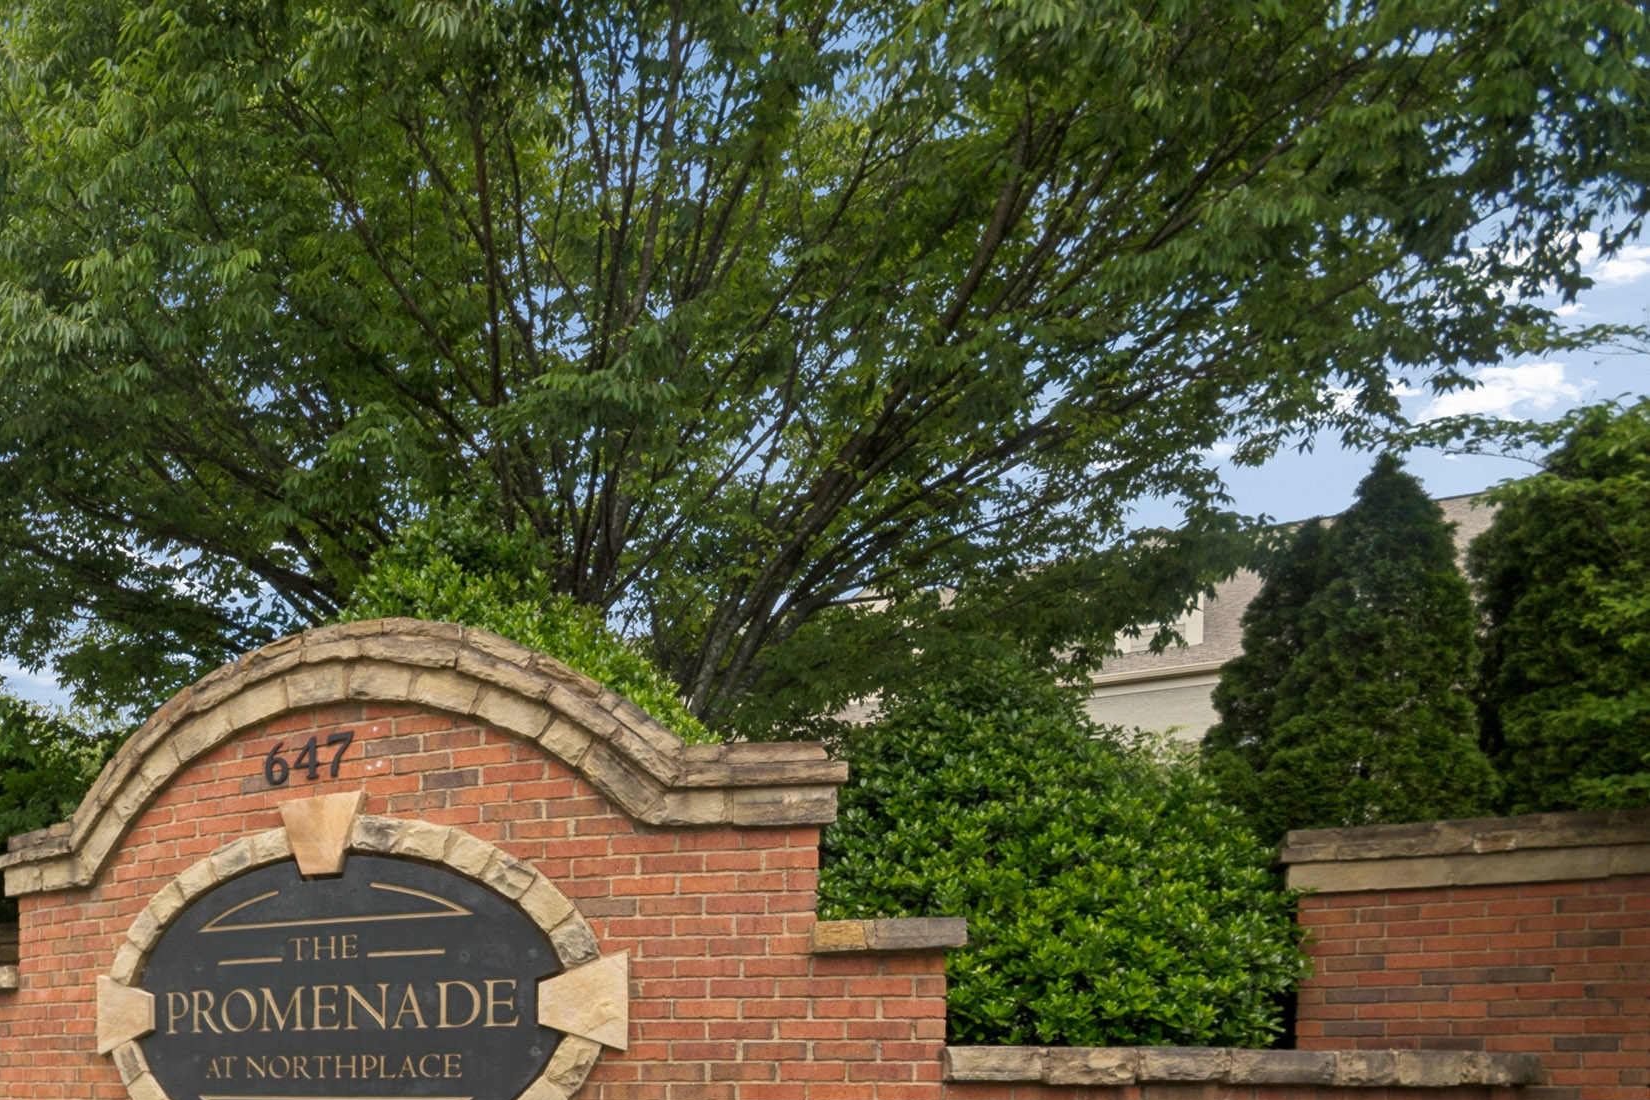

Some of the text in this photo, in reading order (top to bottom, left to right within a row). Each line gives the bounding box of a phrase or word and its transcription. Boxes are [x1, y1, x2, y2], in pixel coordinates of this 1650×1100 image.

[264, 730, 354, 785] 647
[288, 934, 358, 961] THE
[165, 978, 520, 1034] PROMENADE
[205, 1053, 463, 1080] AT NORTHPLACE
